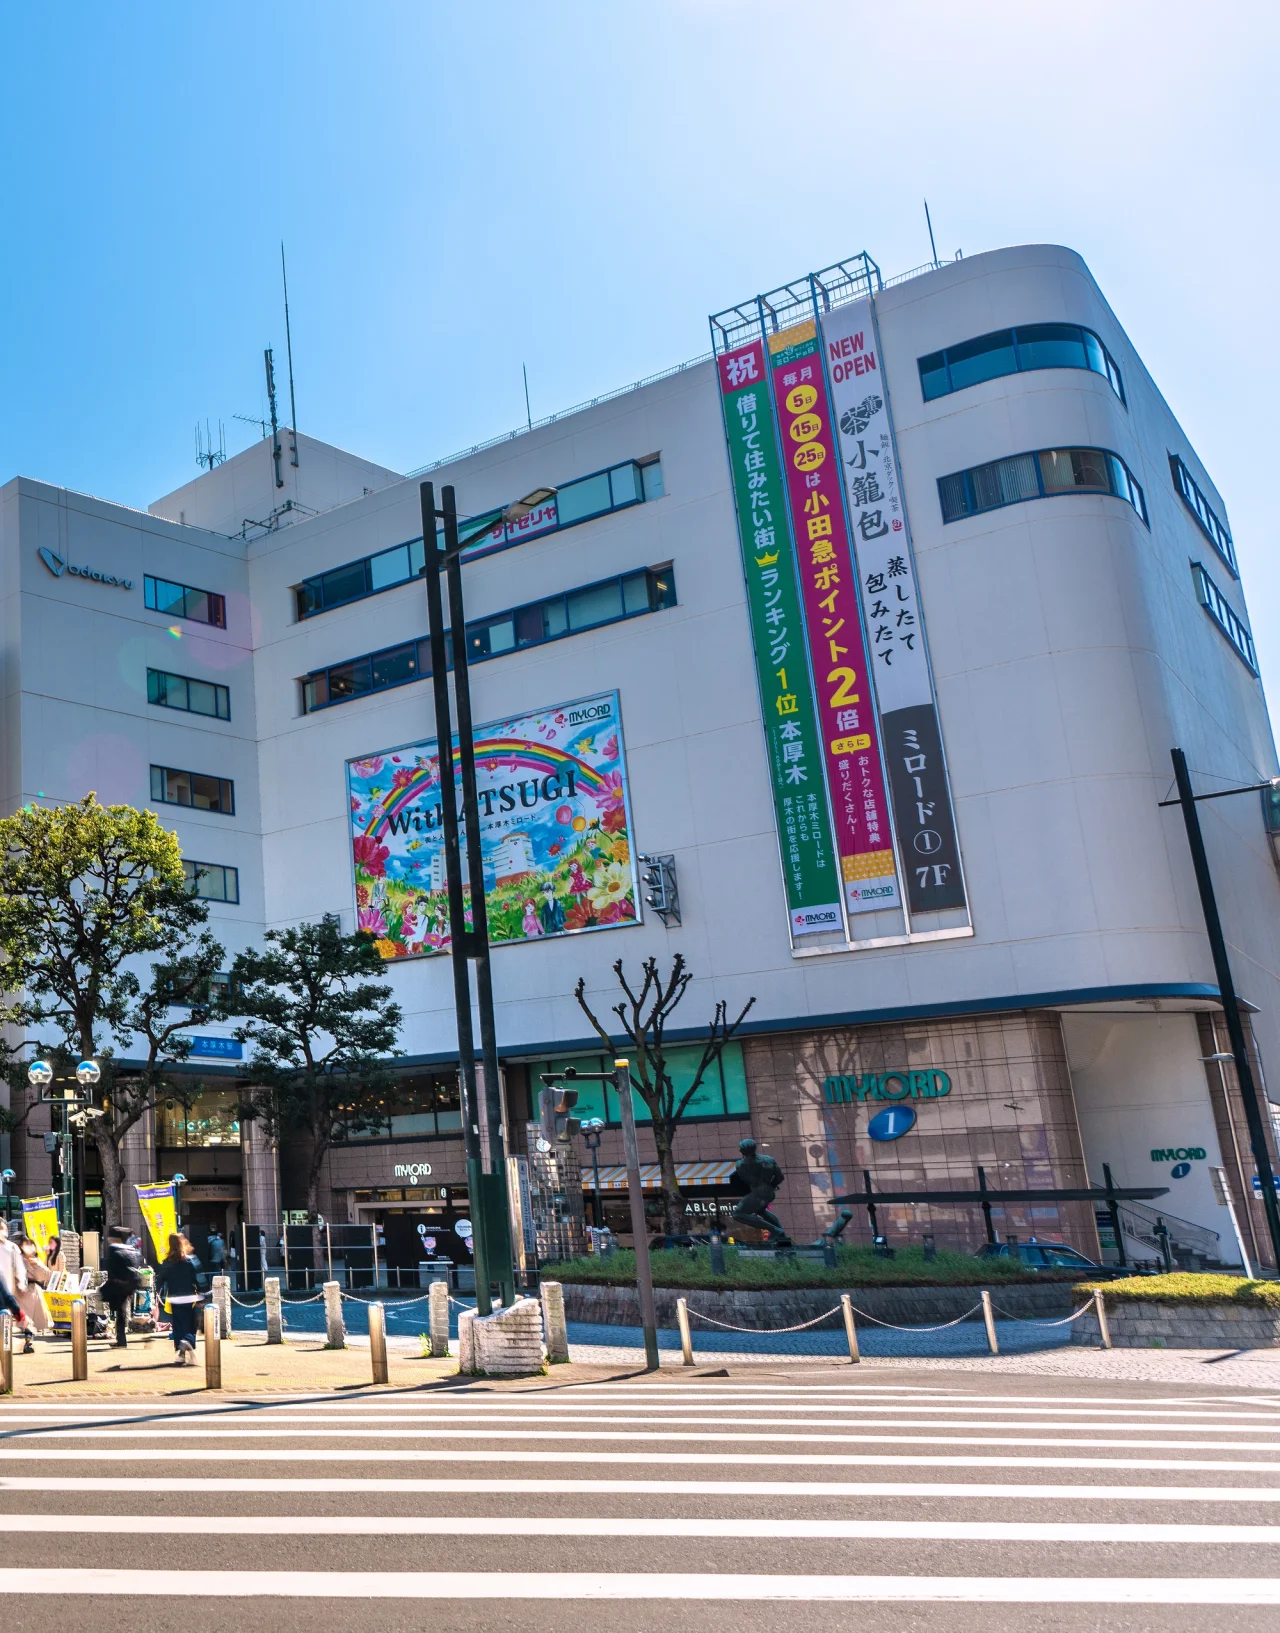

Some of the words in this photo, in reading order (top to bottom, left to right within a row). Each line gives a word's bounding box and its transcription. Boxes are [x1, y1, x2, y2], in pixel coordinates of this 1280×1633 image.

[828, 331, 865, 361] NEW
[726, 351, 759, 387] 祝
[783, 367, 813, 387] 毎月
[832, 351, 877, 384] OPEN
[793, 393, 813, 408] 5日
[793, 419, 819, 438] 15日
[796, 447, 825, 468] 25日
[736, 392, 776, 550] 借りて住みたい街
[846, 440, 889, 542] 小籠包
[67, 565, 137, 591] odakyu
[887, 556, 916, 651] 蒸したて
[866, 573, 894, 666] 包みたて
[569, 704, 611, 722] MYLORD
[837, 738, 865, 751] さらに
[858, 756, 881, 844] おトクな店舗特典
[795, 794, 809, 841] これからも
[807, 793, 826, 869] 本厚木ミロードは
[916, 864, 951, 888] 7F
[861, 886, 894, 897] MYLORD
[805, 911, 837, 923] MYLORD
[824, 1069, 951, 1103] MYLORD
[1151, 1147, 1206, 1162] MYLORD
[394, 1163, 432, 1177] MYLORD
[685, 1203, 716, 1212] ABLO
